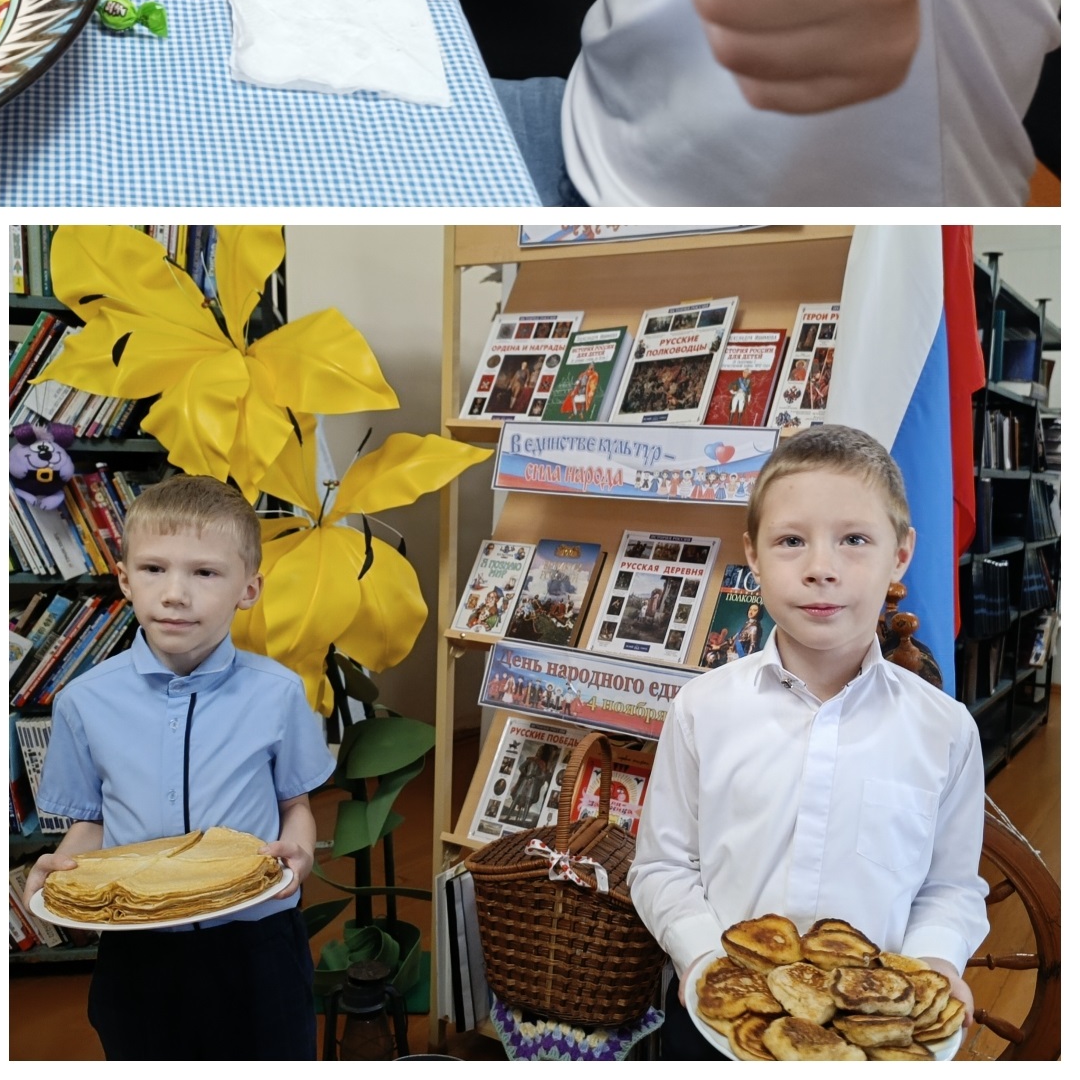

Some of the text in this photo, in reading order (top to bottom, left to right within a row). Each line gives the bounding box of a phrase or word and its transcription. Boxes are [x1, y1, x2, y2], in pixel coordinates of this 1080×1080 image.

[659, 335, 699, 346] РУССКИЕ
[530, 344, 565, 352] НАГРАДЫ
[646, 344, 708, 357] ПОЛКОВОДЦЫ
[621, 562, 704, 576] РУССКАЯ ДЕРЕВНЯ
[725, 594, 763, 605] ПОЛКОВО
[499, 649, 543, 674] День
[547, 662, 645, 694] народного
[586, 695, 597, 711] 4
[510, 727, 545, 741] РУССКИЕ
